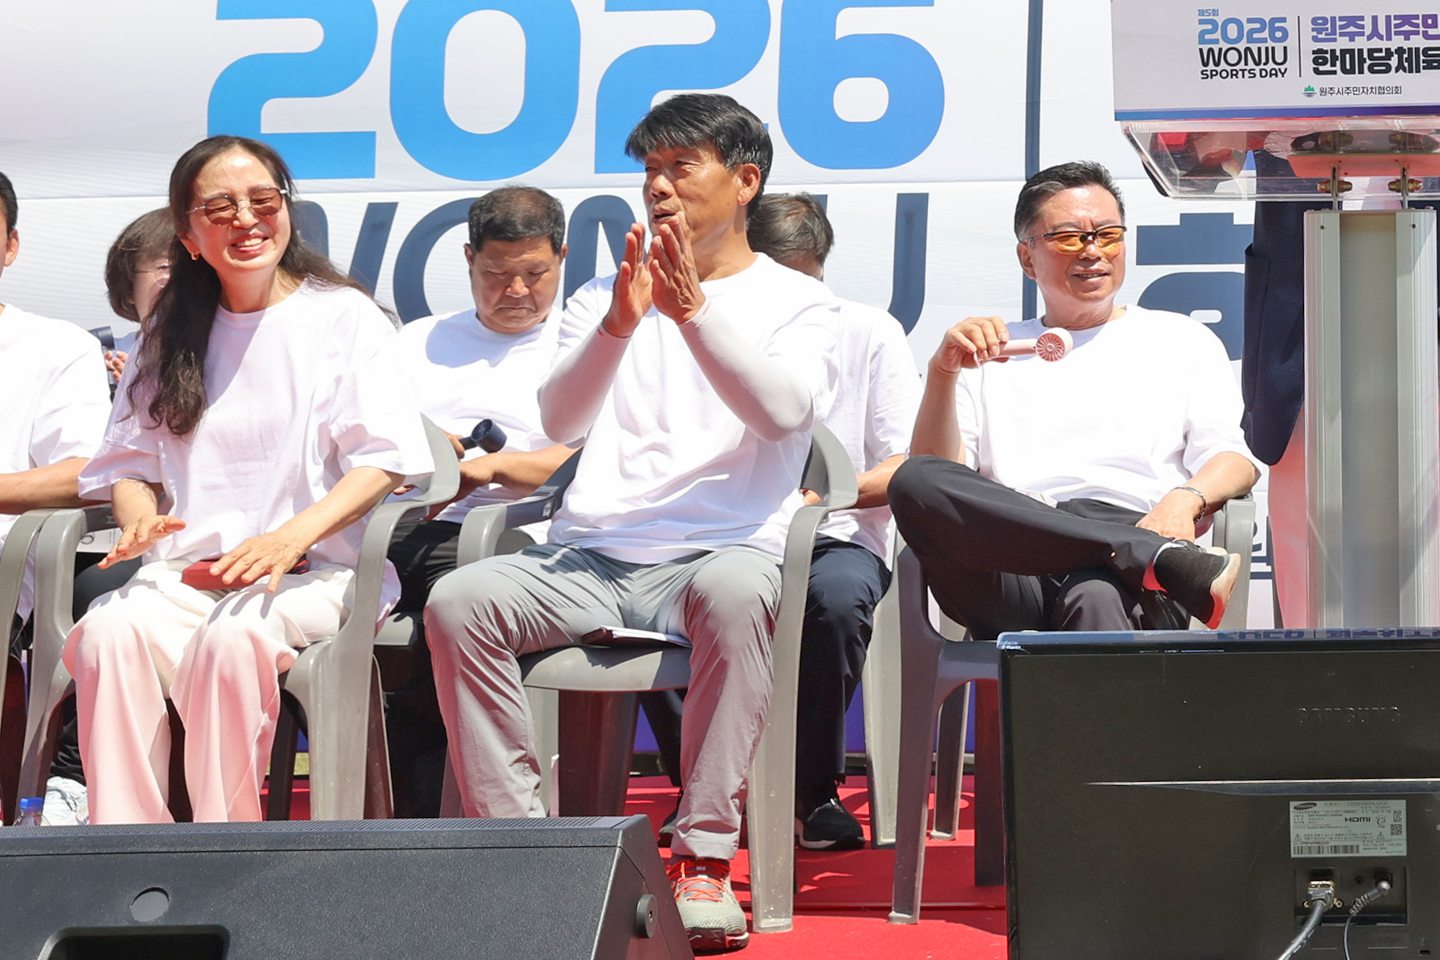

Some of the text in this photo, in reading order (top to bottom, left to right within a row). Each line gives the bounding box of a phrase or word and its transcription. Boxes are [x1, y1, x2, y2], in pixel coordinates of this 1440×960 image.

[1198, 8, 1219, 17] 제5회
[1197, 17, 1289, 45] 2026
[1198, 46, 1288, 68] WONJU
[1200, 67, 1288, 80] SPORTS DAY
[1319, 85, 1402, 97] 원주시주민자치협의회
